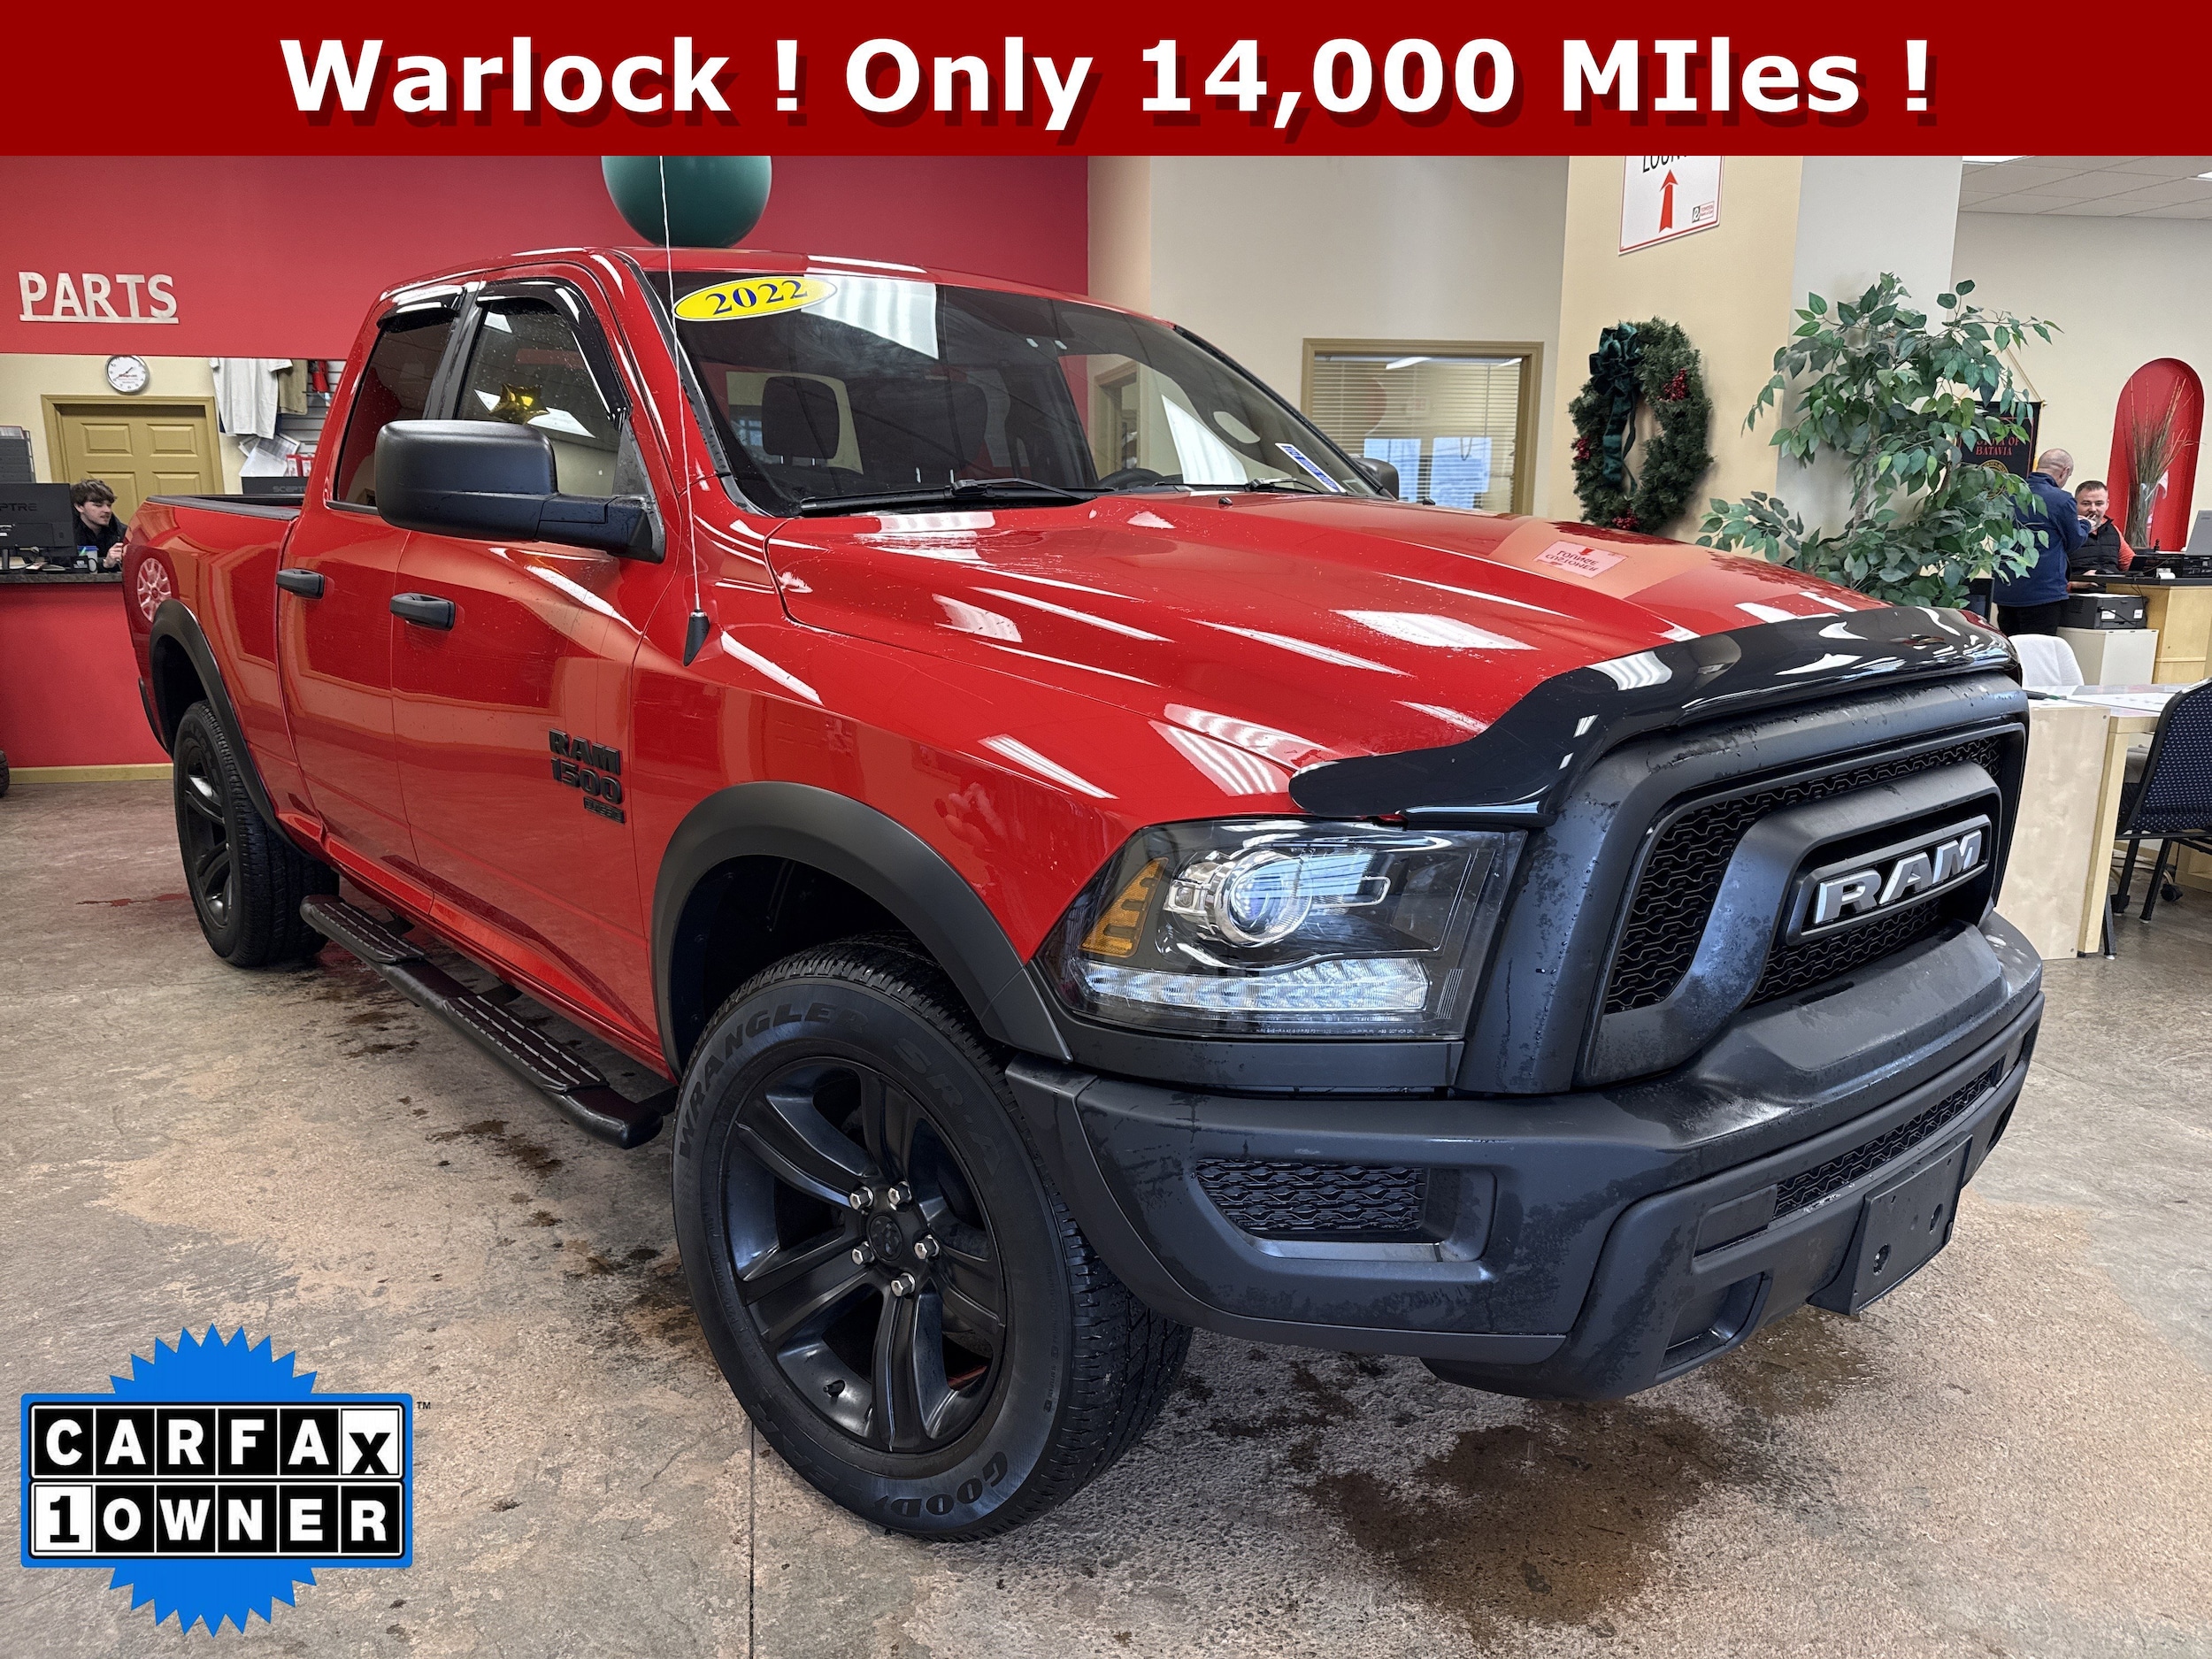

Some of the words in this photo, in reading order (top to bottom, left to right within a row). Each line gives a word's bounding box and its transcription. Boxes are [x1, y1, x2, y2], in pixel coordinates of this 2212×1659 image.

[19, 271, 179, 320] PARTS
[705, 280, 808, 316] 2022
[1976, 446, 2012, 456] BATAVIA
[549, 728, 621, 776] RAM
[551, 757, 624, 805] 1500
[1816, 829, 1982, 924] RAM
[679, 1002, 869, 1159] WRANGLER
